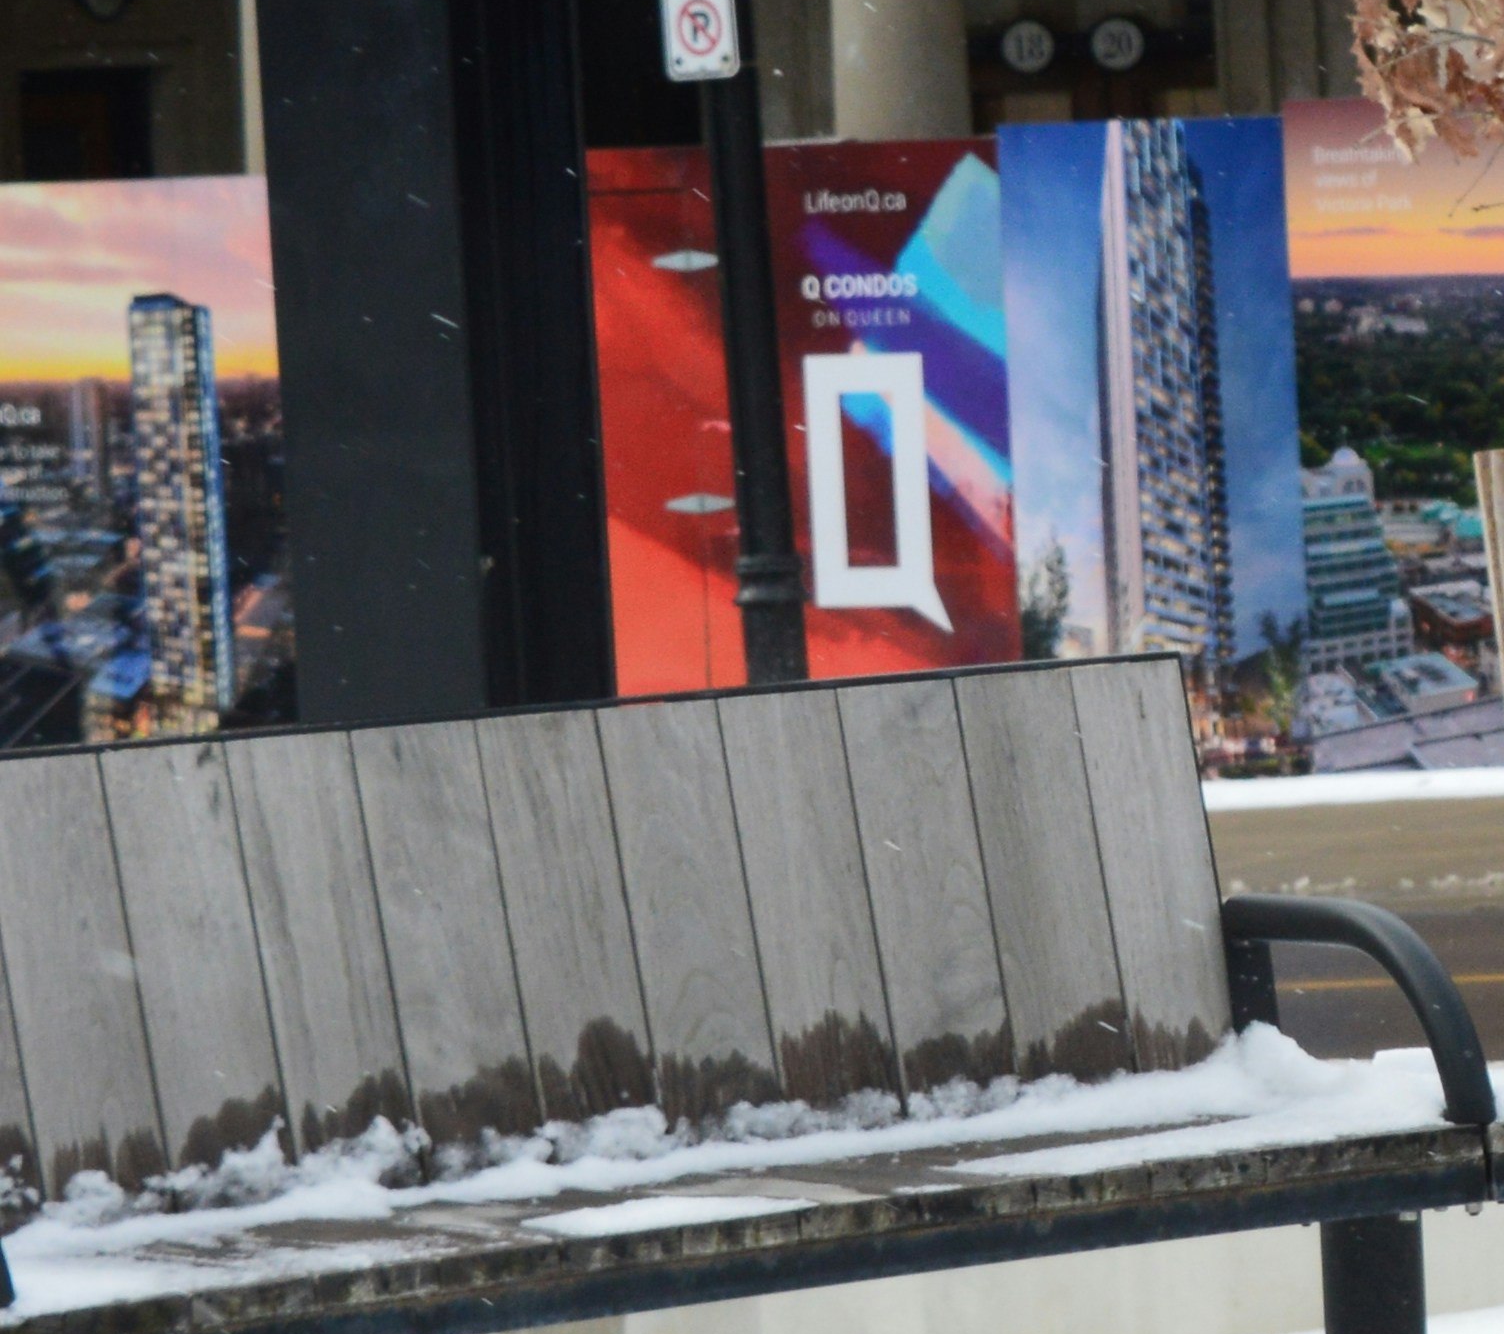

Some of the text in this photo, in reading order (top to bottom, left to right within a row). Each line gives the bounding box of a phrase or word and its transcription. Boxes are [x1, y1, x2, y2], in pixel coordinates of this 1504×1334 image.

[1102, 30, 1132, 60] 20
[804, 190, 906, 213] LifeonQ.ca
[802, 273, 918, 305] Q CONDOS
[812, 308, 911, 328] ON QUEEN
